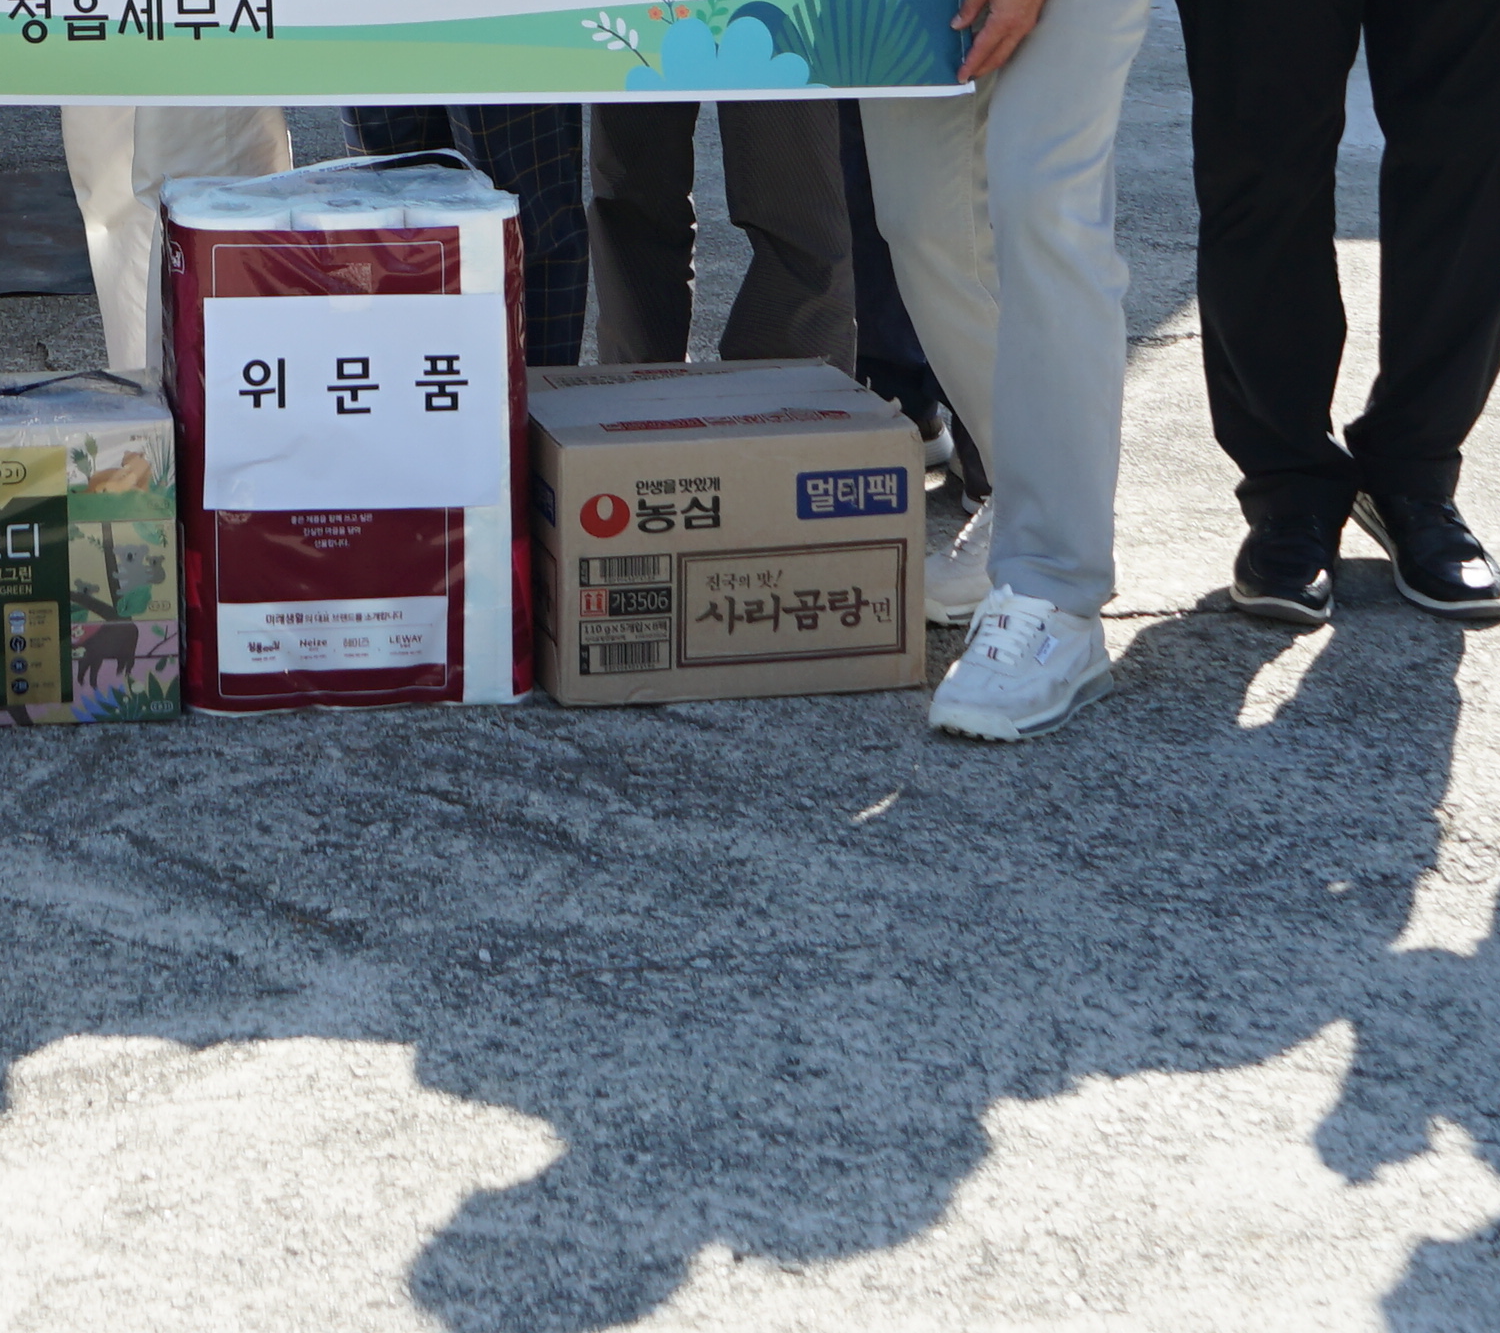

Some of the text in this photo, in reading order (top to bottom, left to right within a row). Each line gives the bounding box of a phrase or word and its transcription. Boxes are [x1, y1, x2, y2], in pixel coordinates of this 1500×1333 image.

[635, 476, 721, 495] 인생을 맛있게
[806, 472, 898, 512] 멀티팩
[635, 495, 721, 533] 농심
[0, 584, 33, 596] GREEN
[705, 569, 783, 591] 진국의 맛!
[611, 590, 669, 614] 가3506
[695, 586, 892, 636] 사리곰탕면
